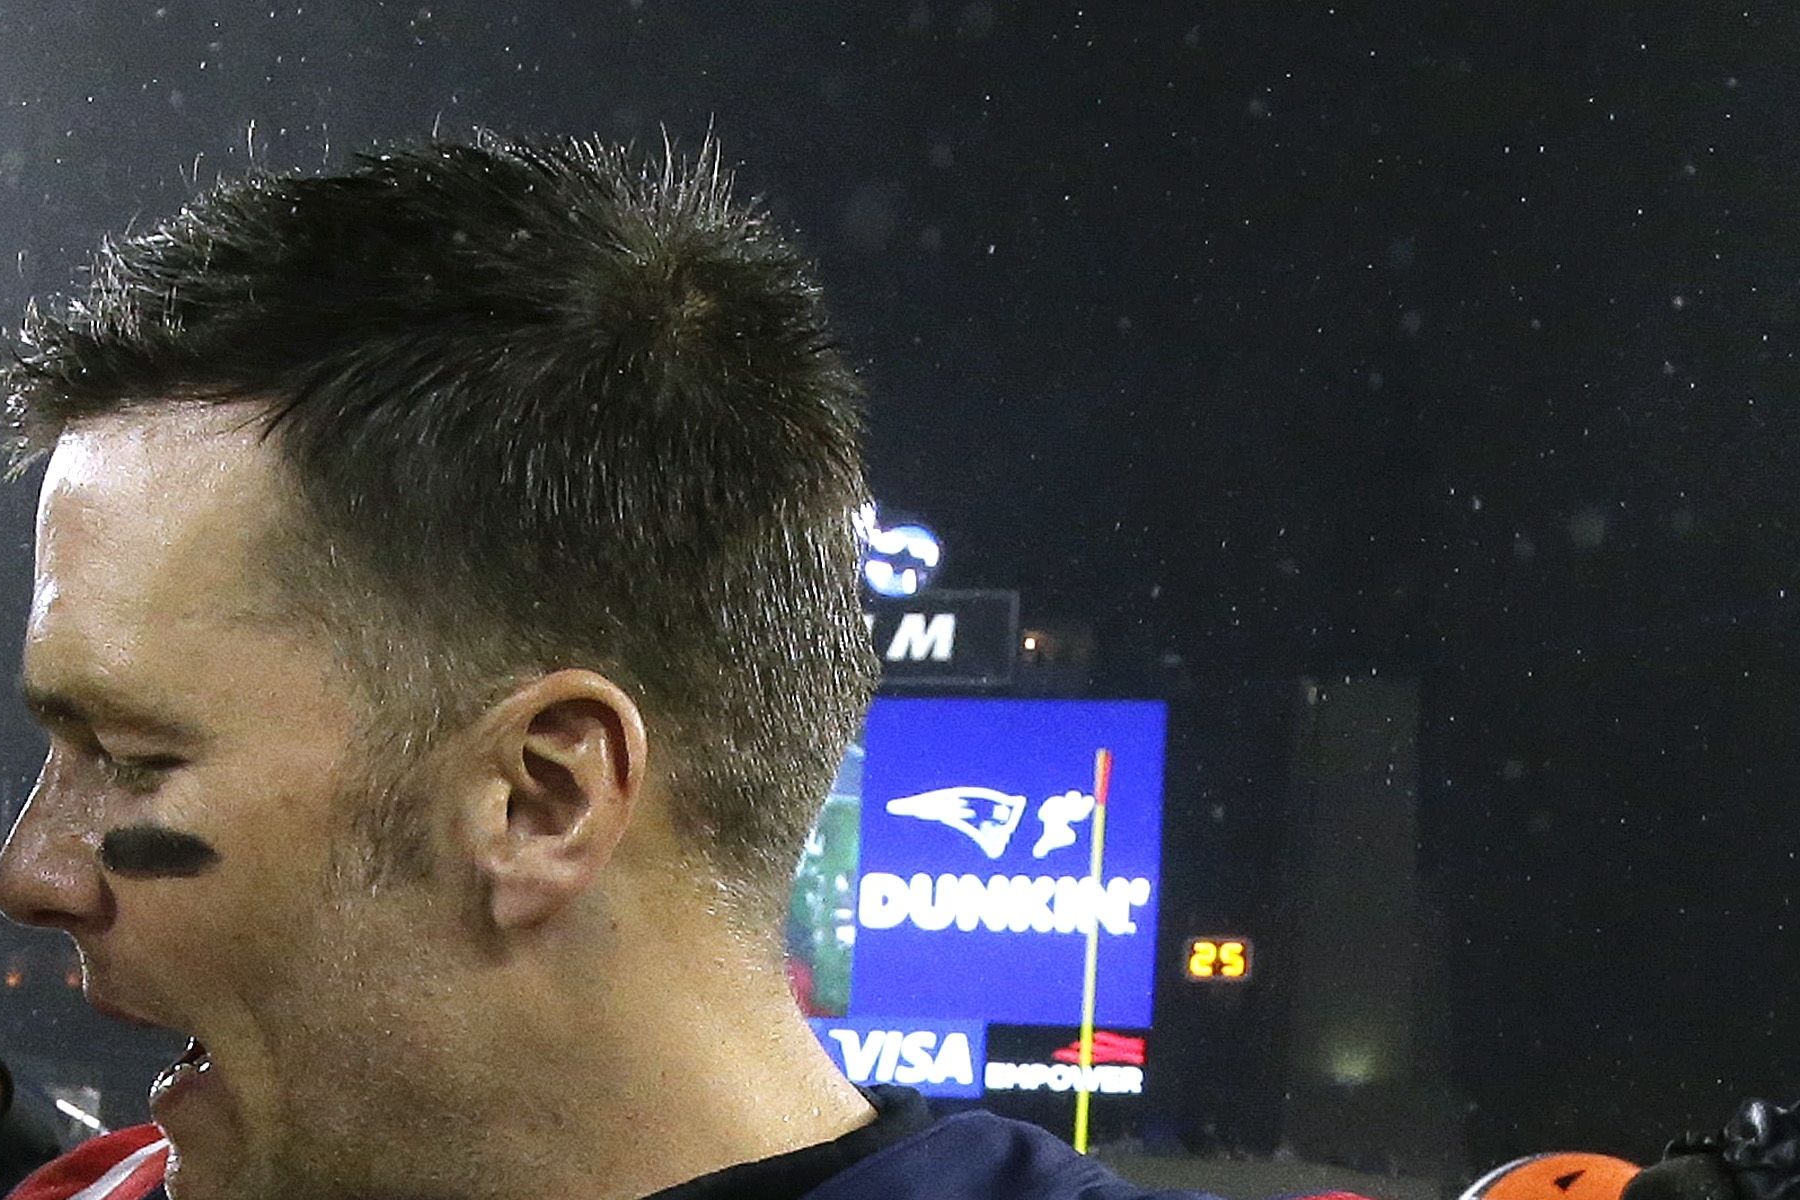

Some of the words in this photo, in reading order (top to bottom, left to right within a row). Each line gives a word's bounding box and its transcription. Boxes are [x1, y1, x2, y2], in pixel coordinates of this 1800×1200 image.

[864, 613, 957, 662] M
[1190, 942, 1245, 977] 25
[828, 1029, 973, 1085] VISA
[985, 1062, 1143, 1093] EMPOWER
